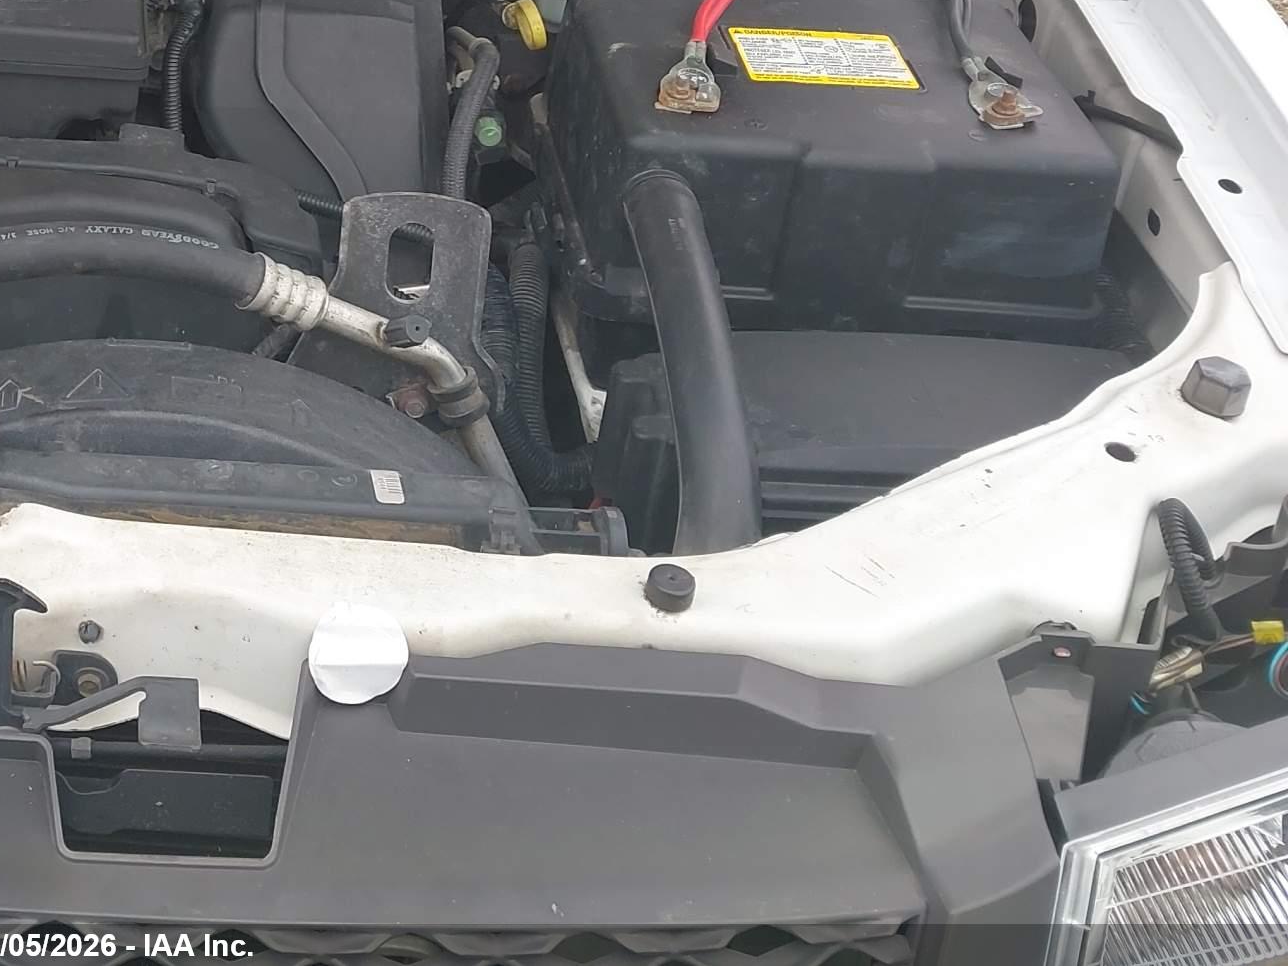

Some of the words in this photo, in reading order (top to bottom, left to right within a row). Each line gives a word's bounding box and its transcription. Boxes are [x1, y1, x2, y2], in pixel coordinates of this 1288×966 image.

[26, 227, 53, 236] HOSE
[84, 225, 134, 236] GALAXY
[141, 228, 220, 250] GOODYEAR
